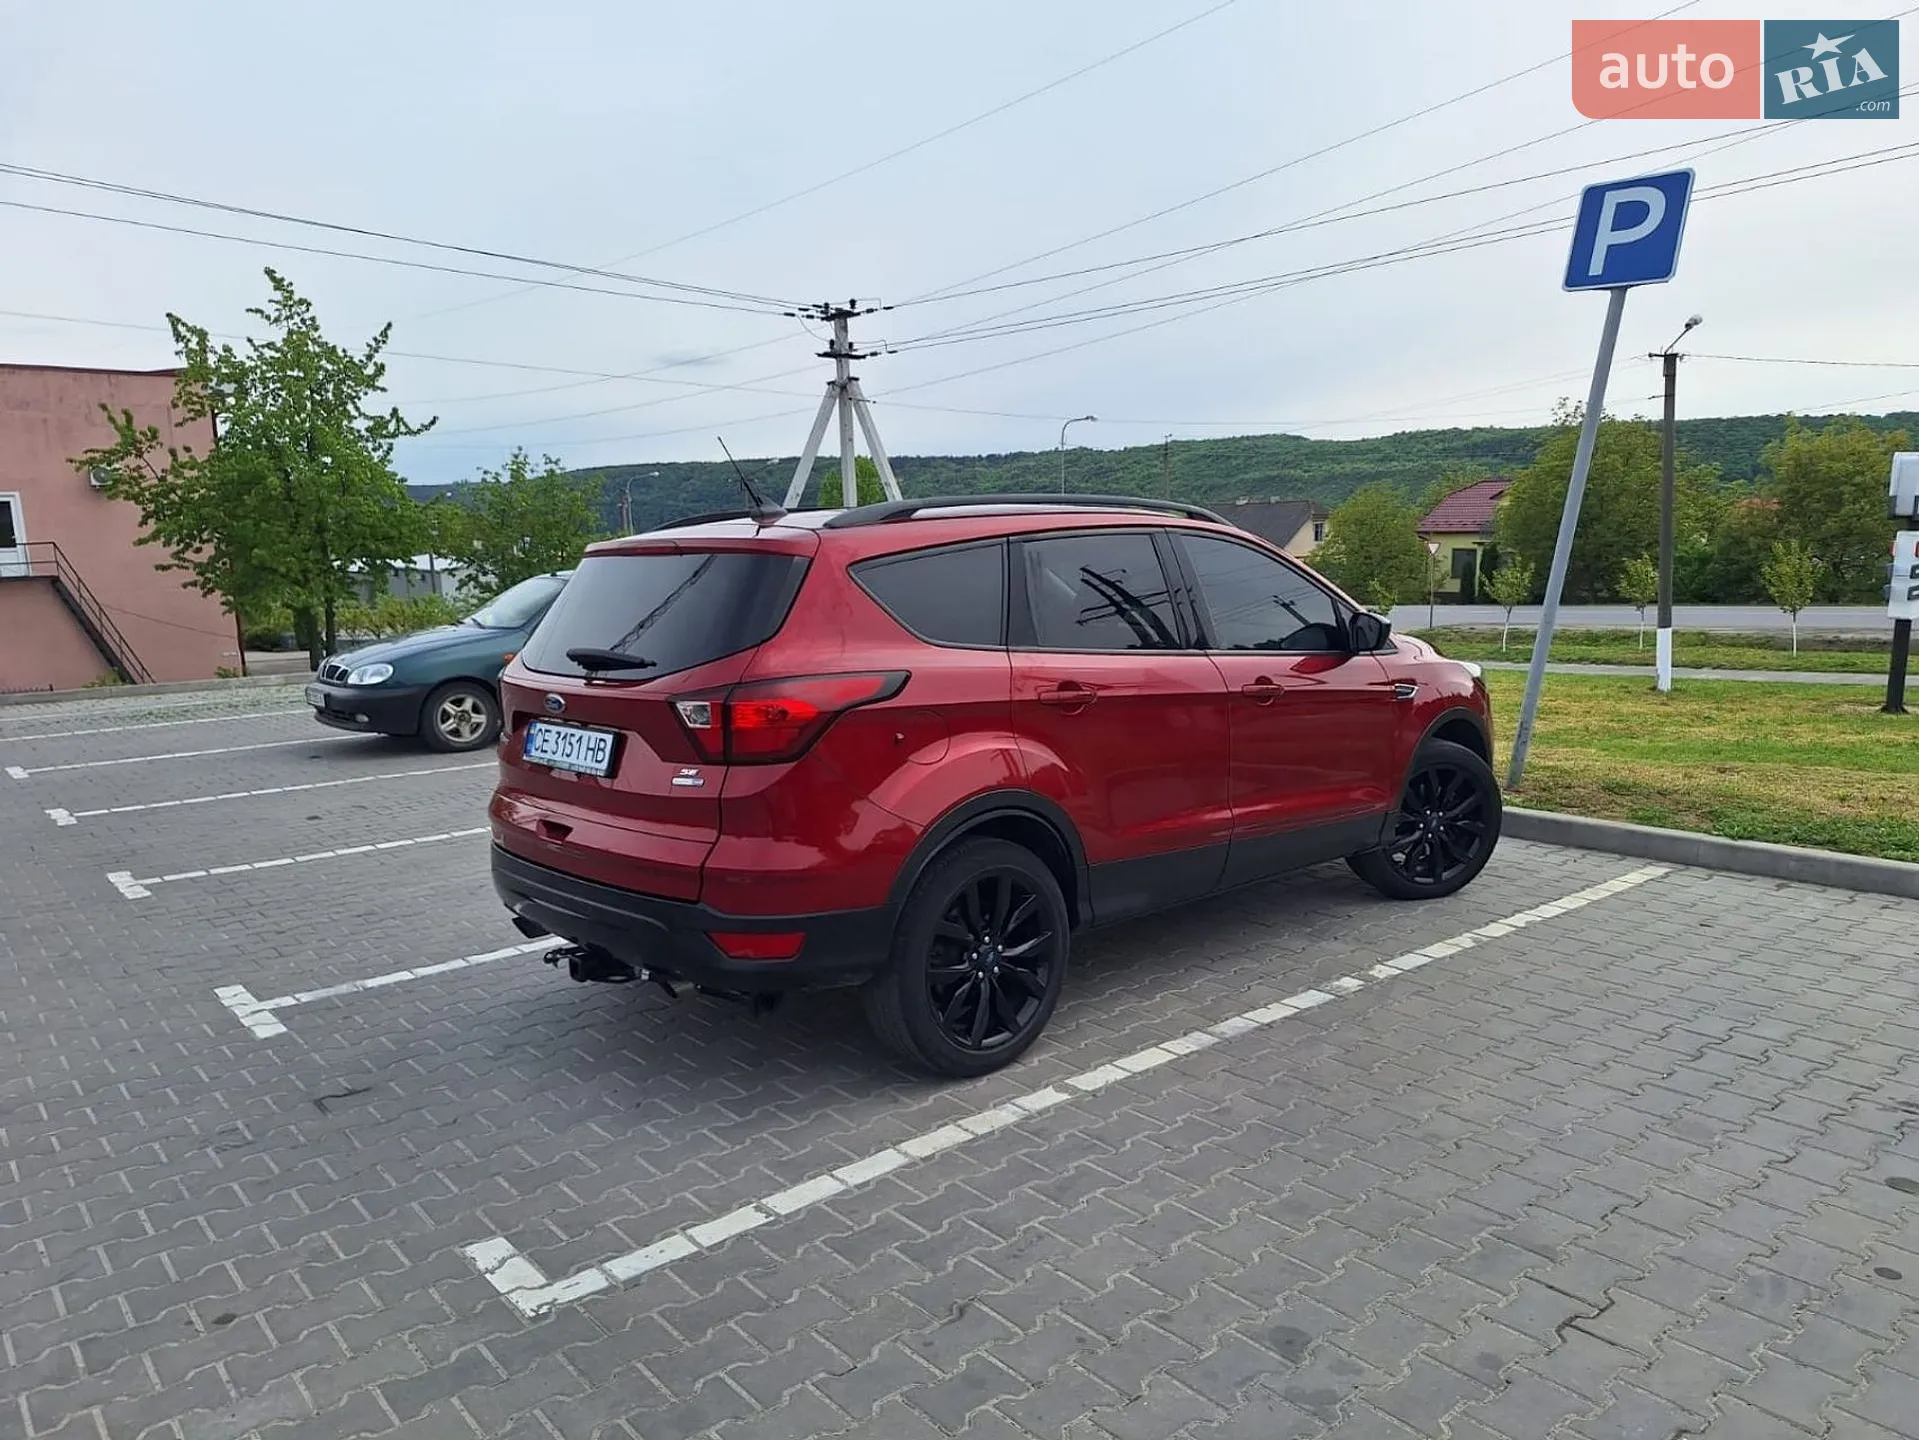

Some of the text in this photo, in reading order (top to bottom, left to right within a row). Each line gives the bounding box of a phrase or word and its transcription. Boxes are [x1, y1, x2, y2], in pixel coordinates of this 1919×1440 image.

[1588, 186, 1666, 276] P
[534, 728, 608, 764] CE 3151 HB
